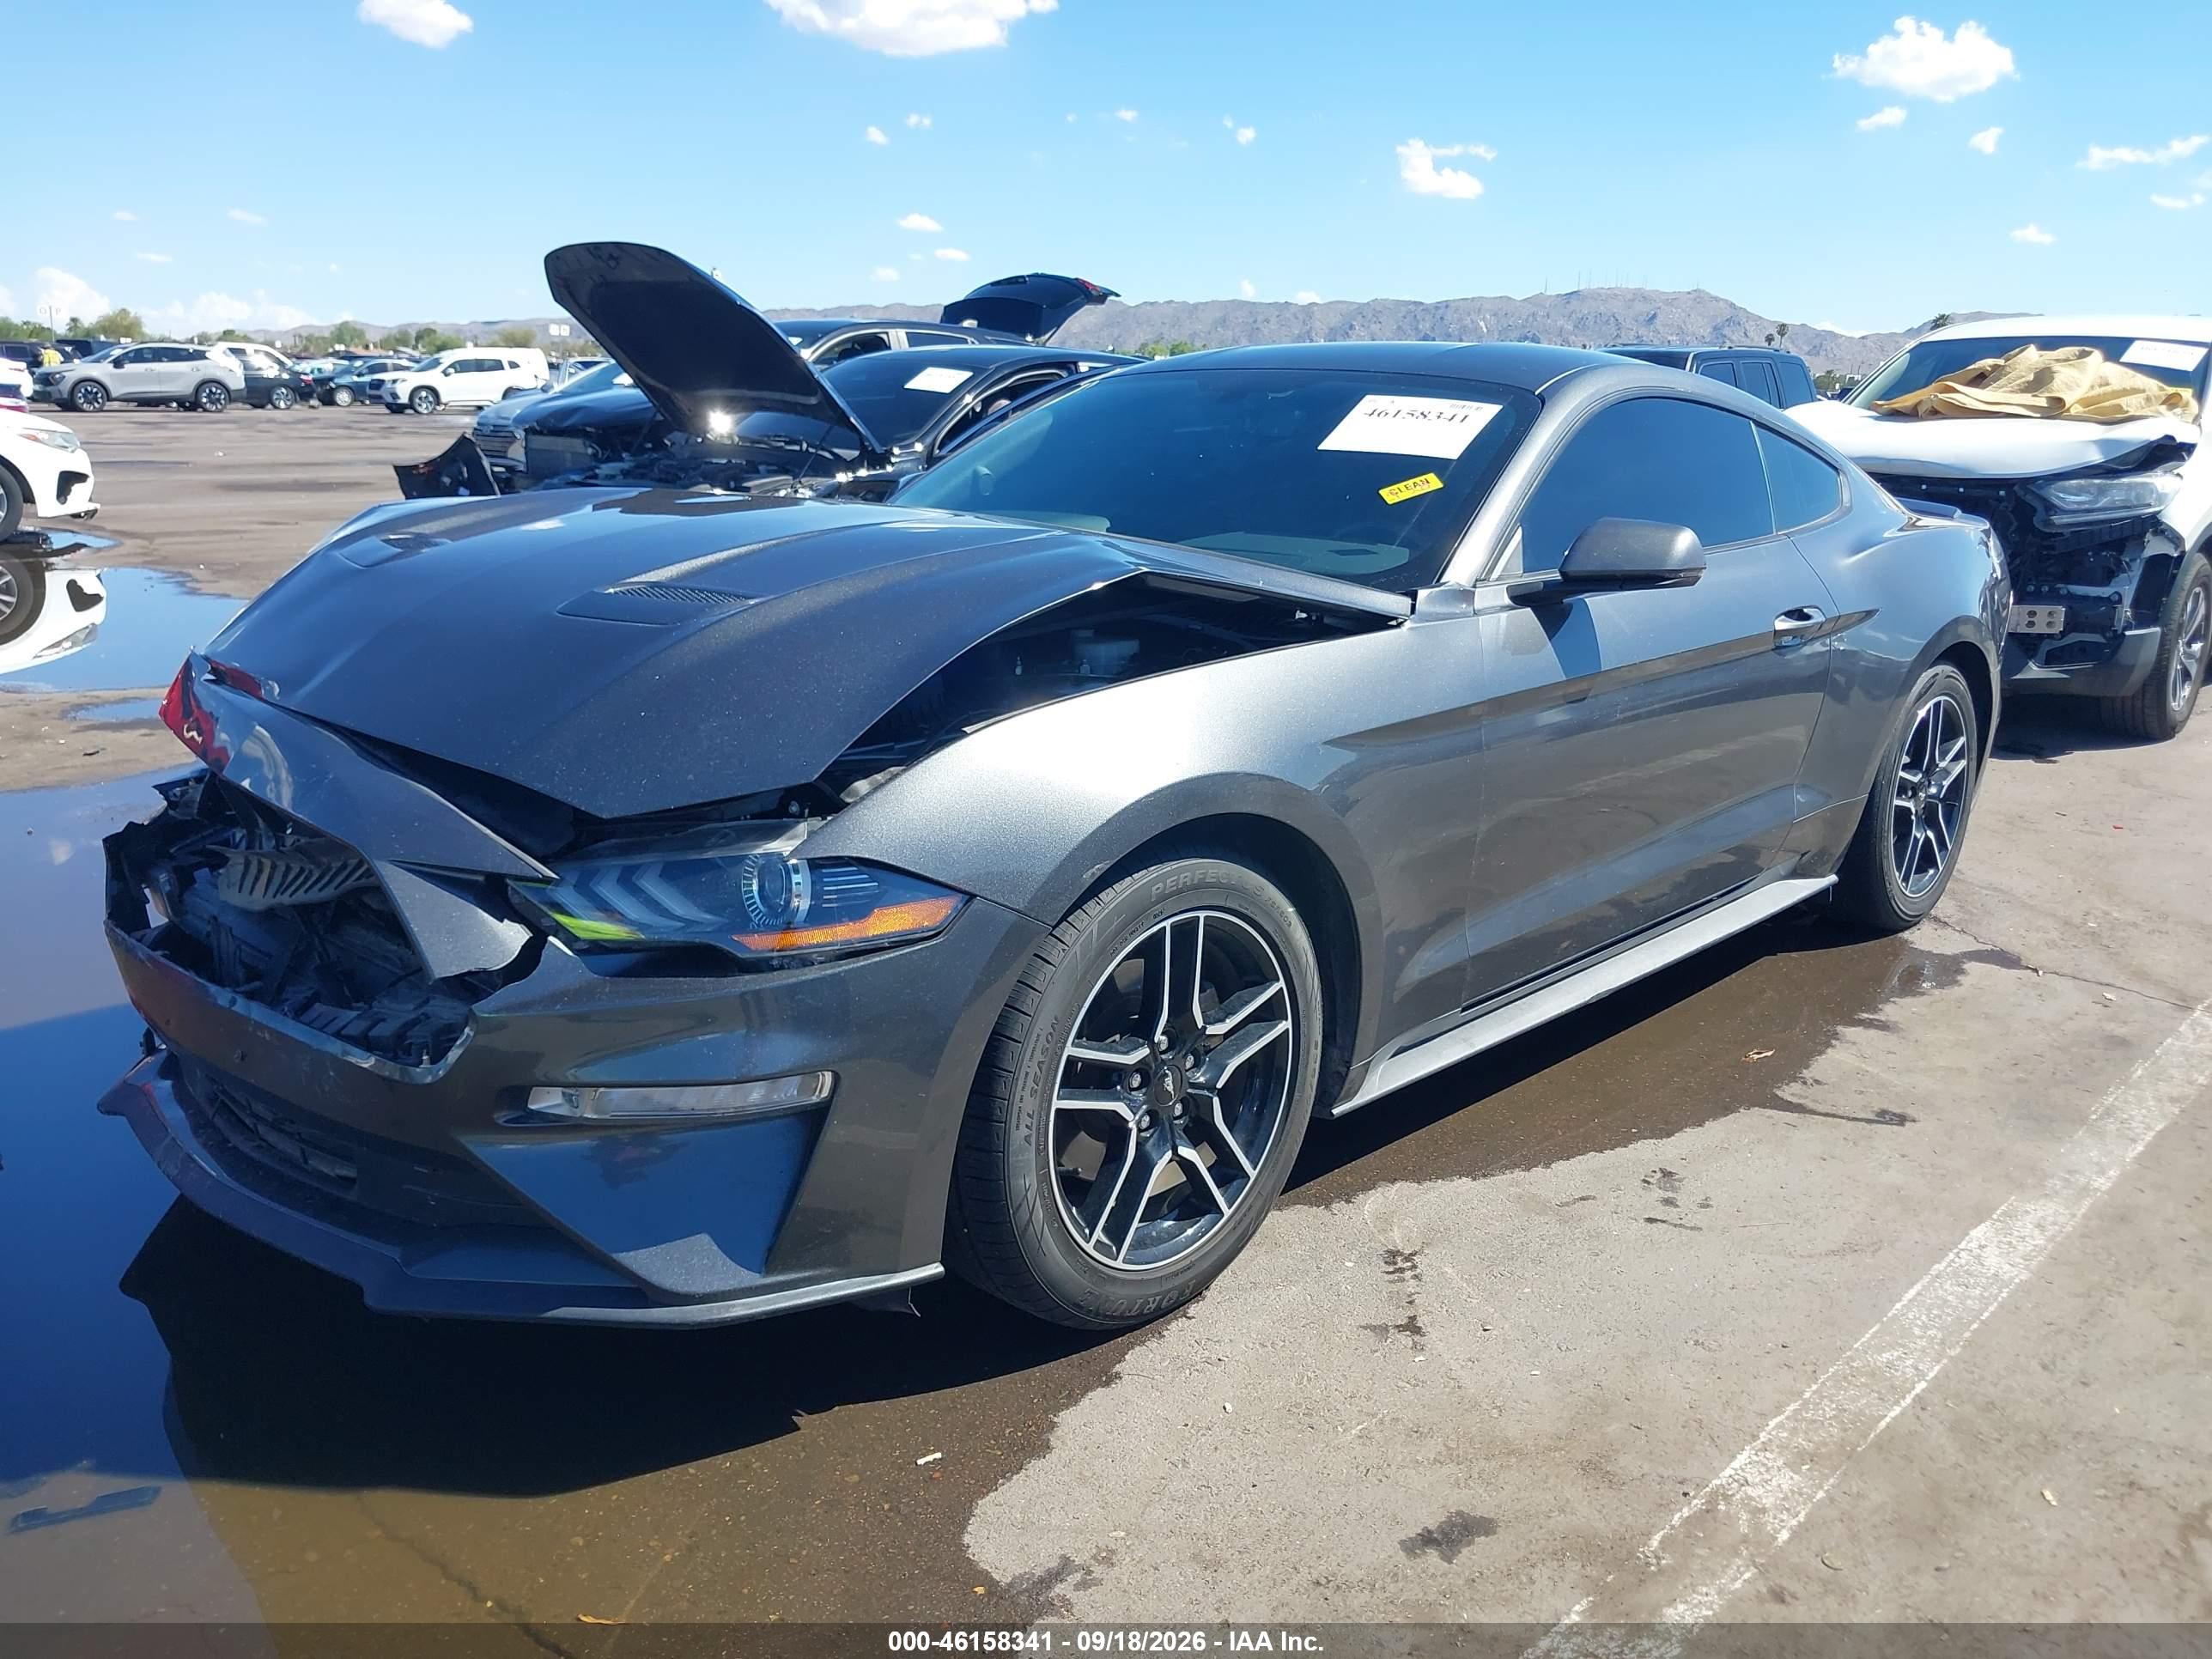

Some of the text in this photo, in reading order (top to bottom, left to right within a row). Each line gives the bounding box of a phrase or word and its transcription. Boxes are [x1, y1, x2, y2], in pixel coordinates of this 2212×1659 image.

[1364, 407, 1469, 423] 46158341
[1388, 477, 1431, 497] CLEAN
[1151, 868, 1265, 902] PERFECS
[1024, 1014, 1059, 1146] ALL SEASON
[1079, 1279, 1196, 1317] FORTUE
